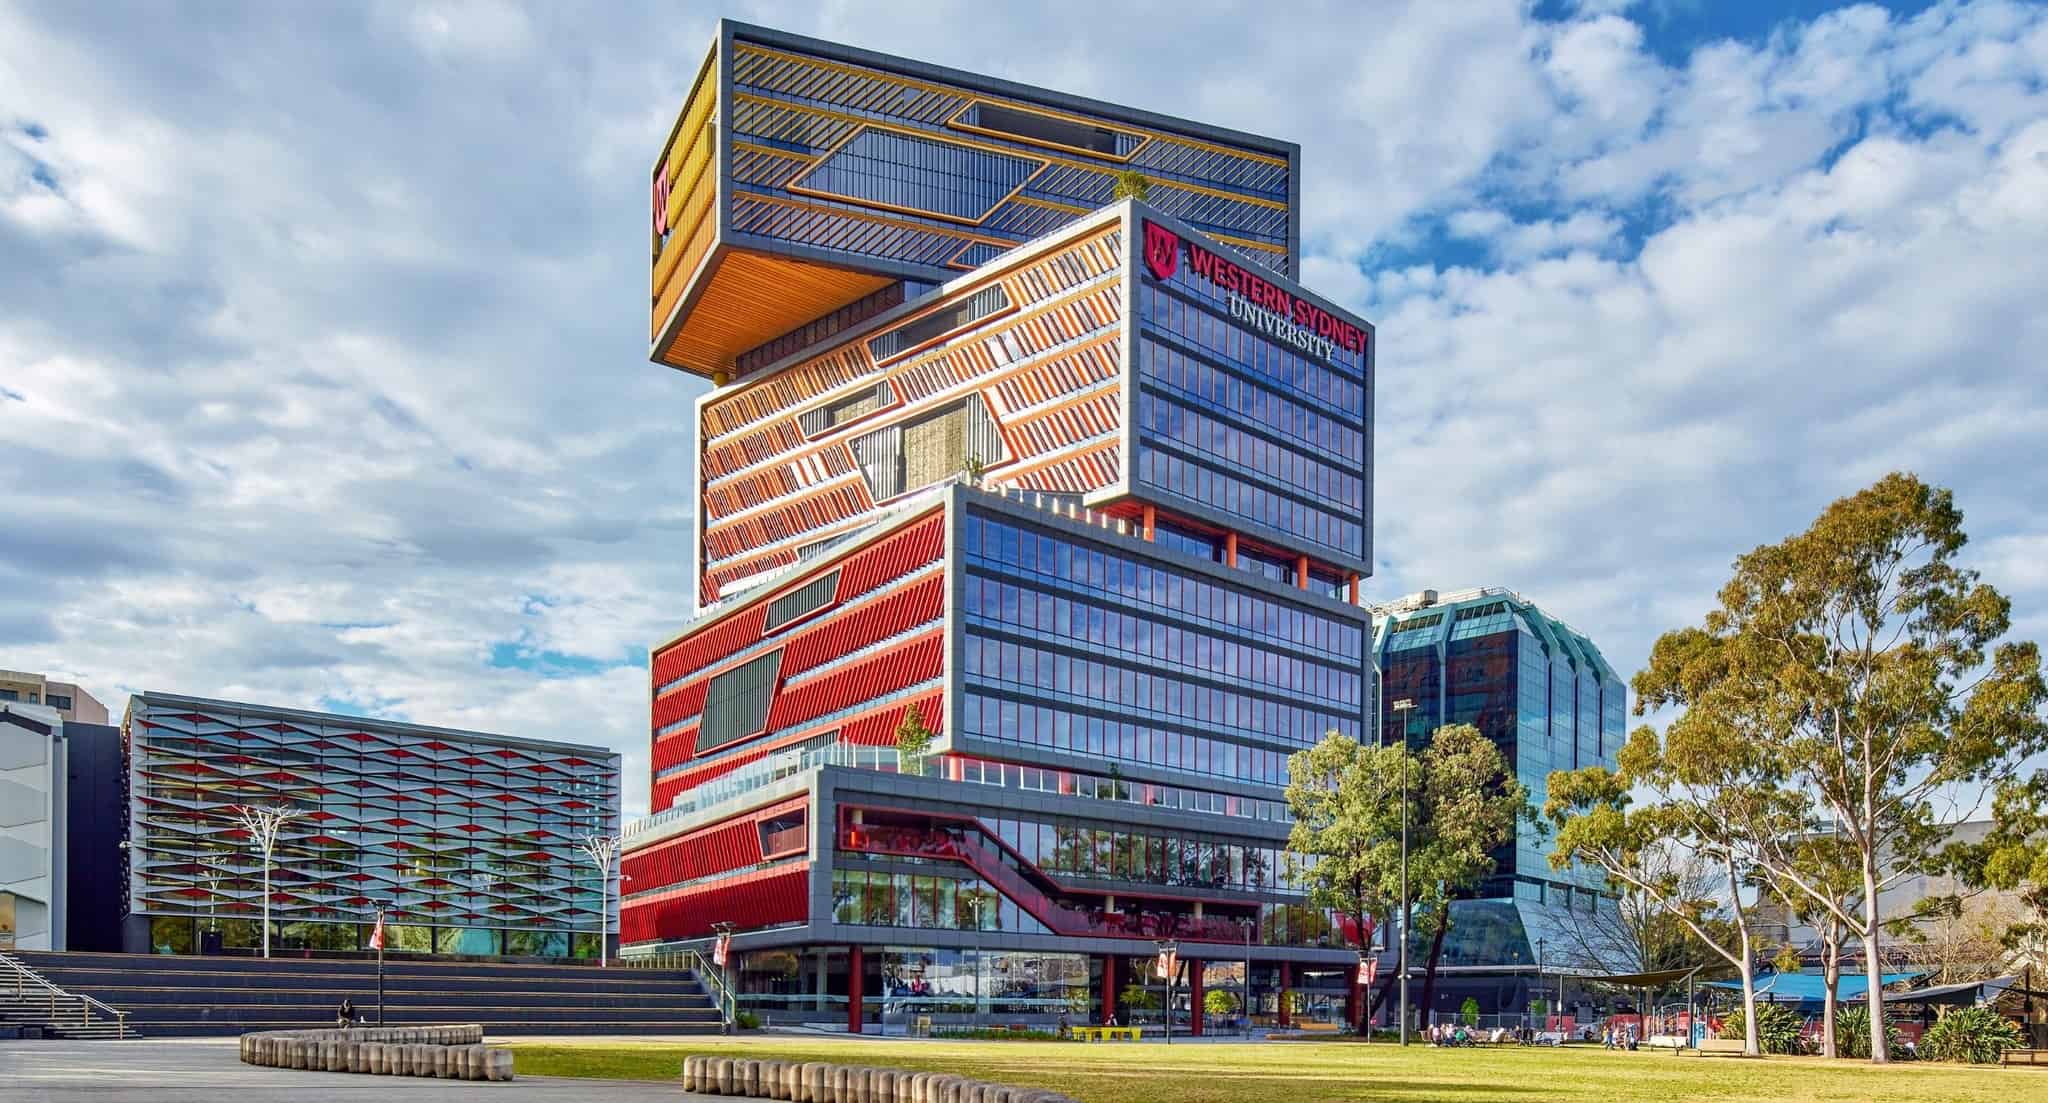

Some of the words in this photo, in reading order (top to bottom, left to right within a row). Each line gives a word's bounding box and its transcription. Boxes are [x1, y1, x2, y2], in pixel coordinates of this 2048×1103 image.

[1190, 244, 1290, 317] WESTERN
[1295, 299, 1368, 353] SYDNEY
[1228, 295, 1335, 361] UNIVERSITY
